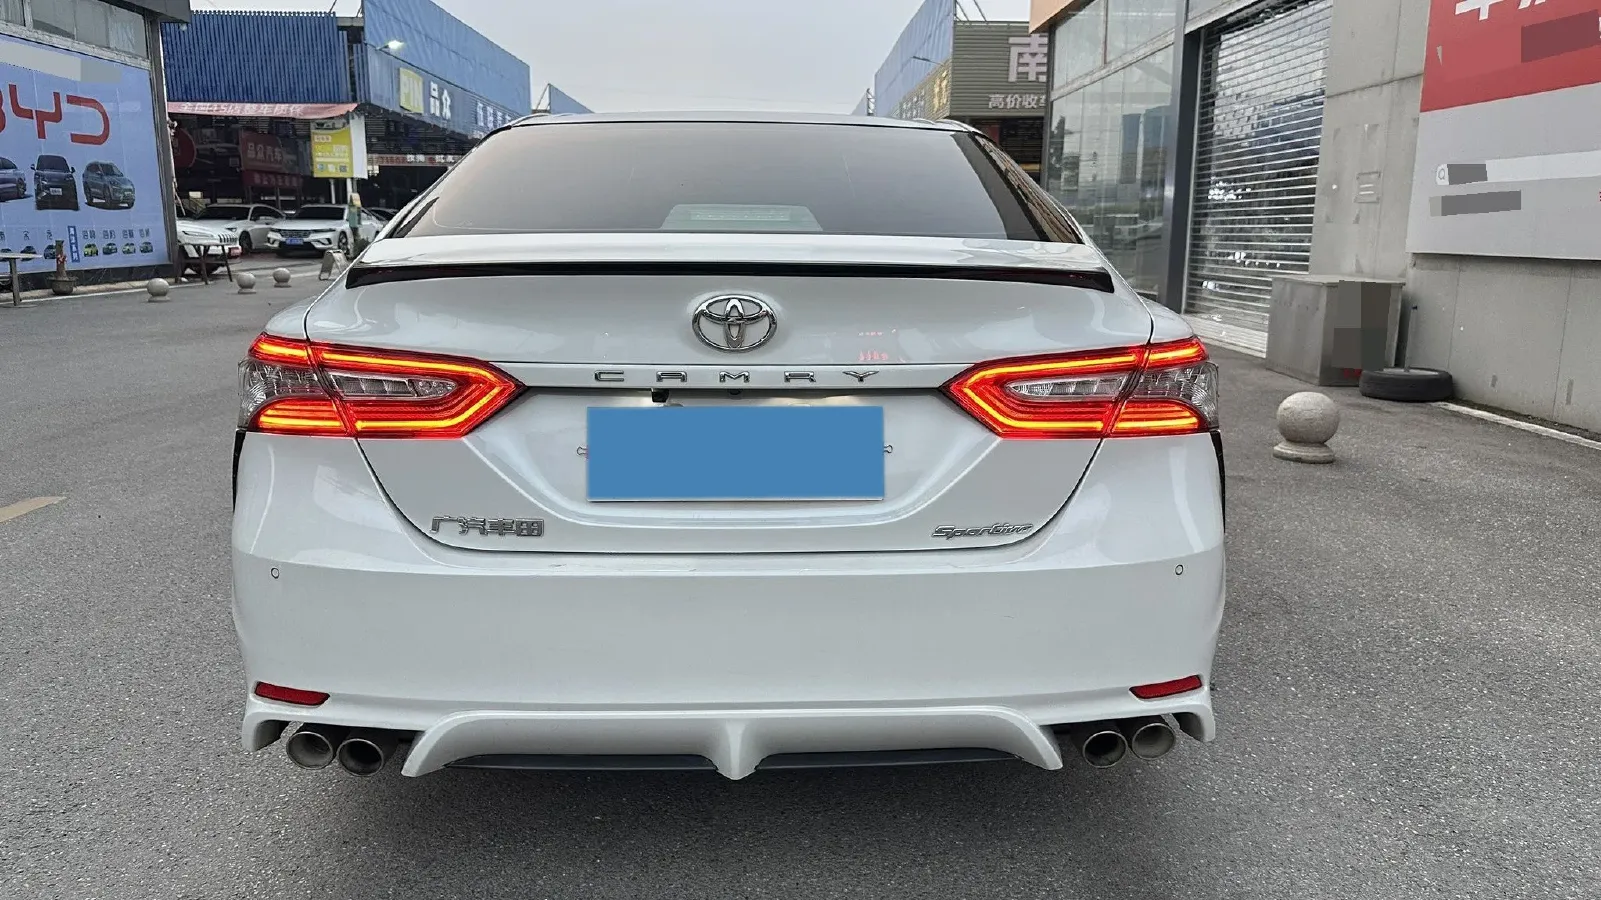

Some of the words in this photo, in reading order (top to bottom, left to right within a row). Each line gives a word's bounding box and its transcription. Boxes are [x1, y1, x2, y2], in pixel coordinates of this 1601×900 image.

[1008, 33, 1048, 82] 南
[0, 84, 110, 146] YD
[430, 81, 451, 120] 品众
[594, 369, 880, 383] CAMRY
[430, 515, 545, 537] 广汽丰田
